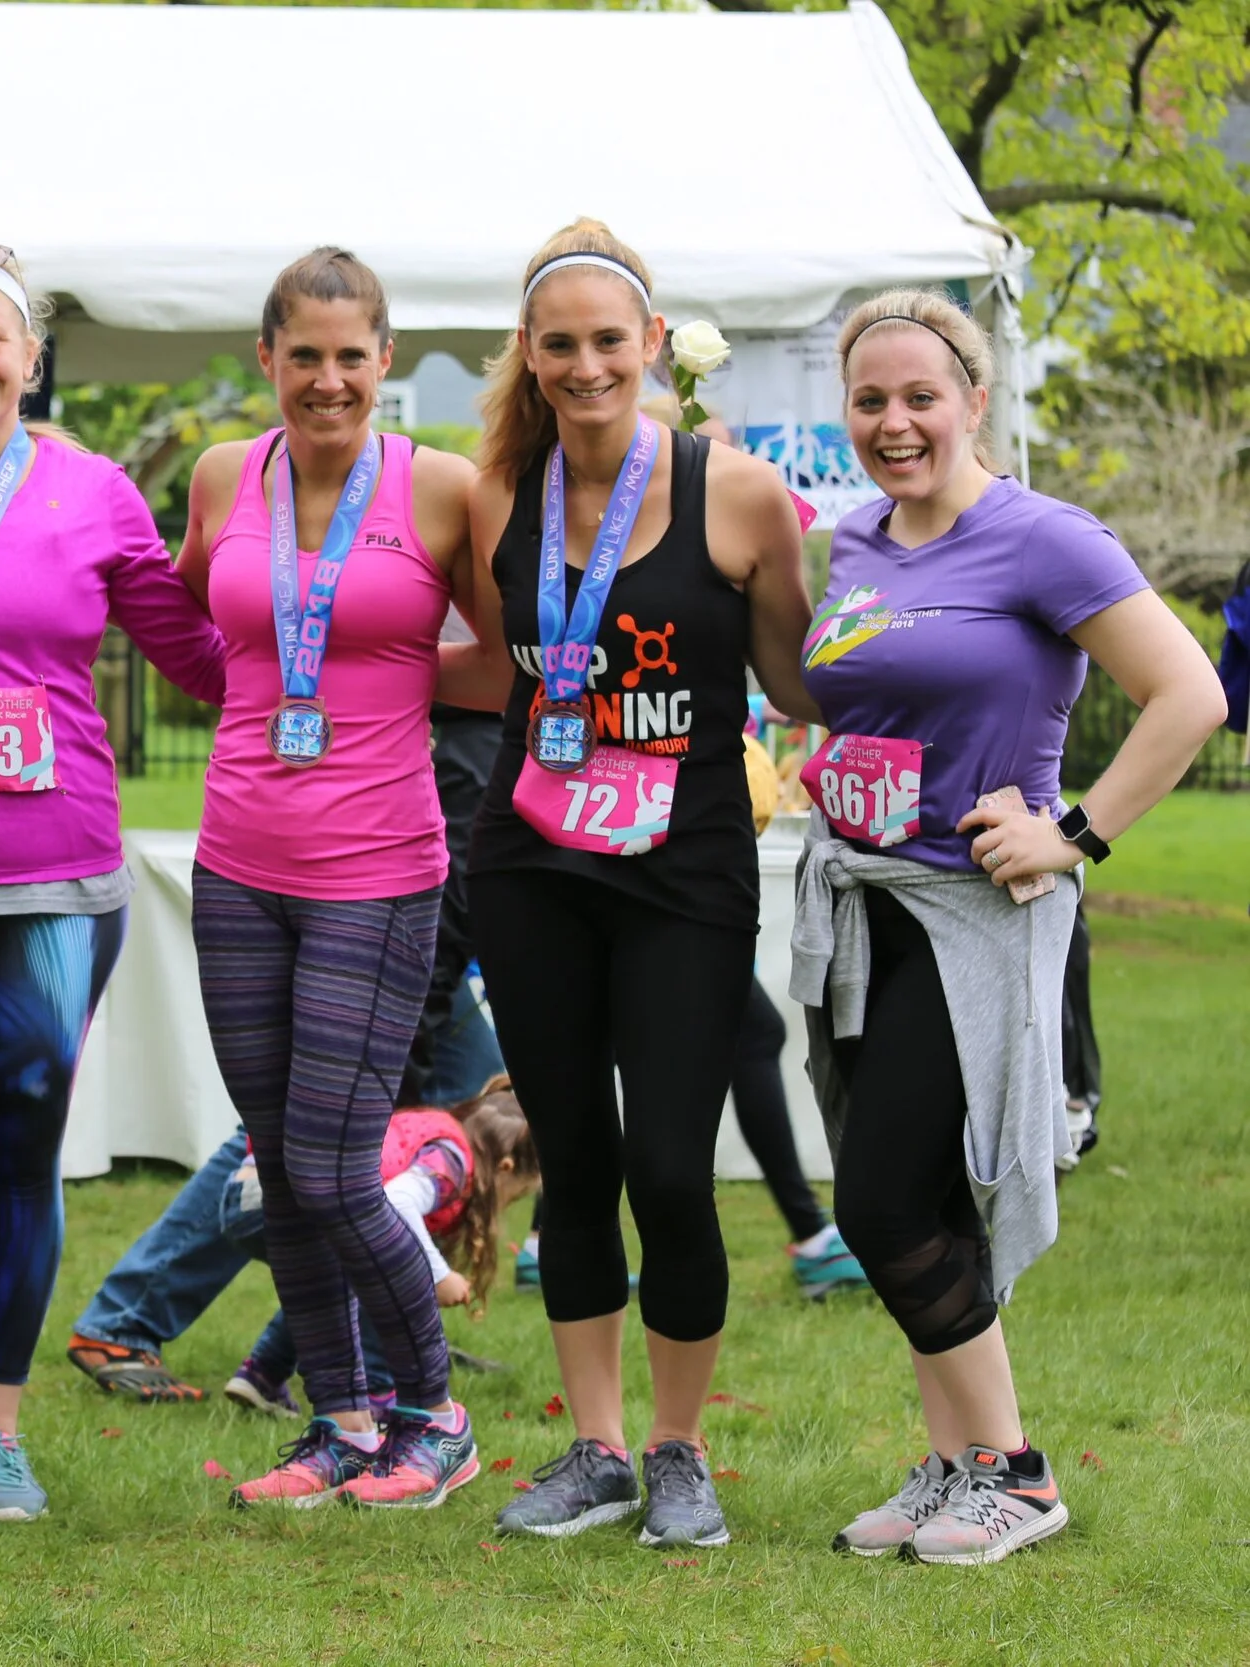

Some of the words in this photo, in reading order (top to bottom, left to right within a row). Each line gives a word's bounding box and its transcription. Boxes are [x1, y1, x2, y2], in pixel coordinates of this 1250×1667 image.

[624, 424, 653, 490] MOTHER
[347, 472, 368, 505] RUN
[550, 492, 559, 504] A
[619, 495, 635, 509] A
[548, 511, 559, 540] LIKE
[609, 511, 628, 545] LIKE
[277, 502, 291, 567] MOTHER
[366, 535, 402, 548] FILA
[546, 547, 558, 580] RUN
[592, 547, 615, 581] RUN
[278, 570, 291, 584] A
[278, 588, 294, 622] LIKE
[295, 559, 342, 677] 2018
[899, 609, 942, 620] MOTHER
[890, 620, 915, 629] 2018
[5, 711, 27, 719] Race
[842, 746, 882, 760] MOTHER
[587, 757, 636, 772] MOTHER
[846, 758, 856, 767] 5K
[857, 759, 875, 770] Race
[591, 768, 604, 777] 5K
[606, 770, 627, 780] Race
[820, 768, 885, 830] 861
[561, 780, 619, 837] 72
[975, 1453, 997, 1465] NIKE
